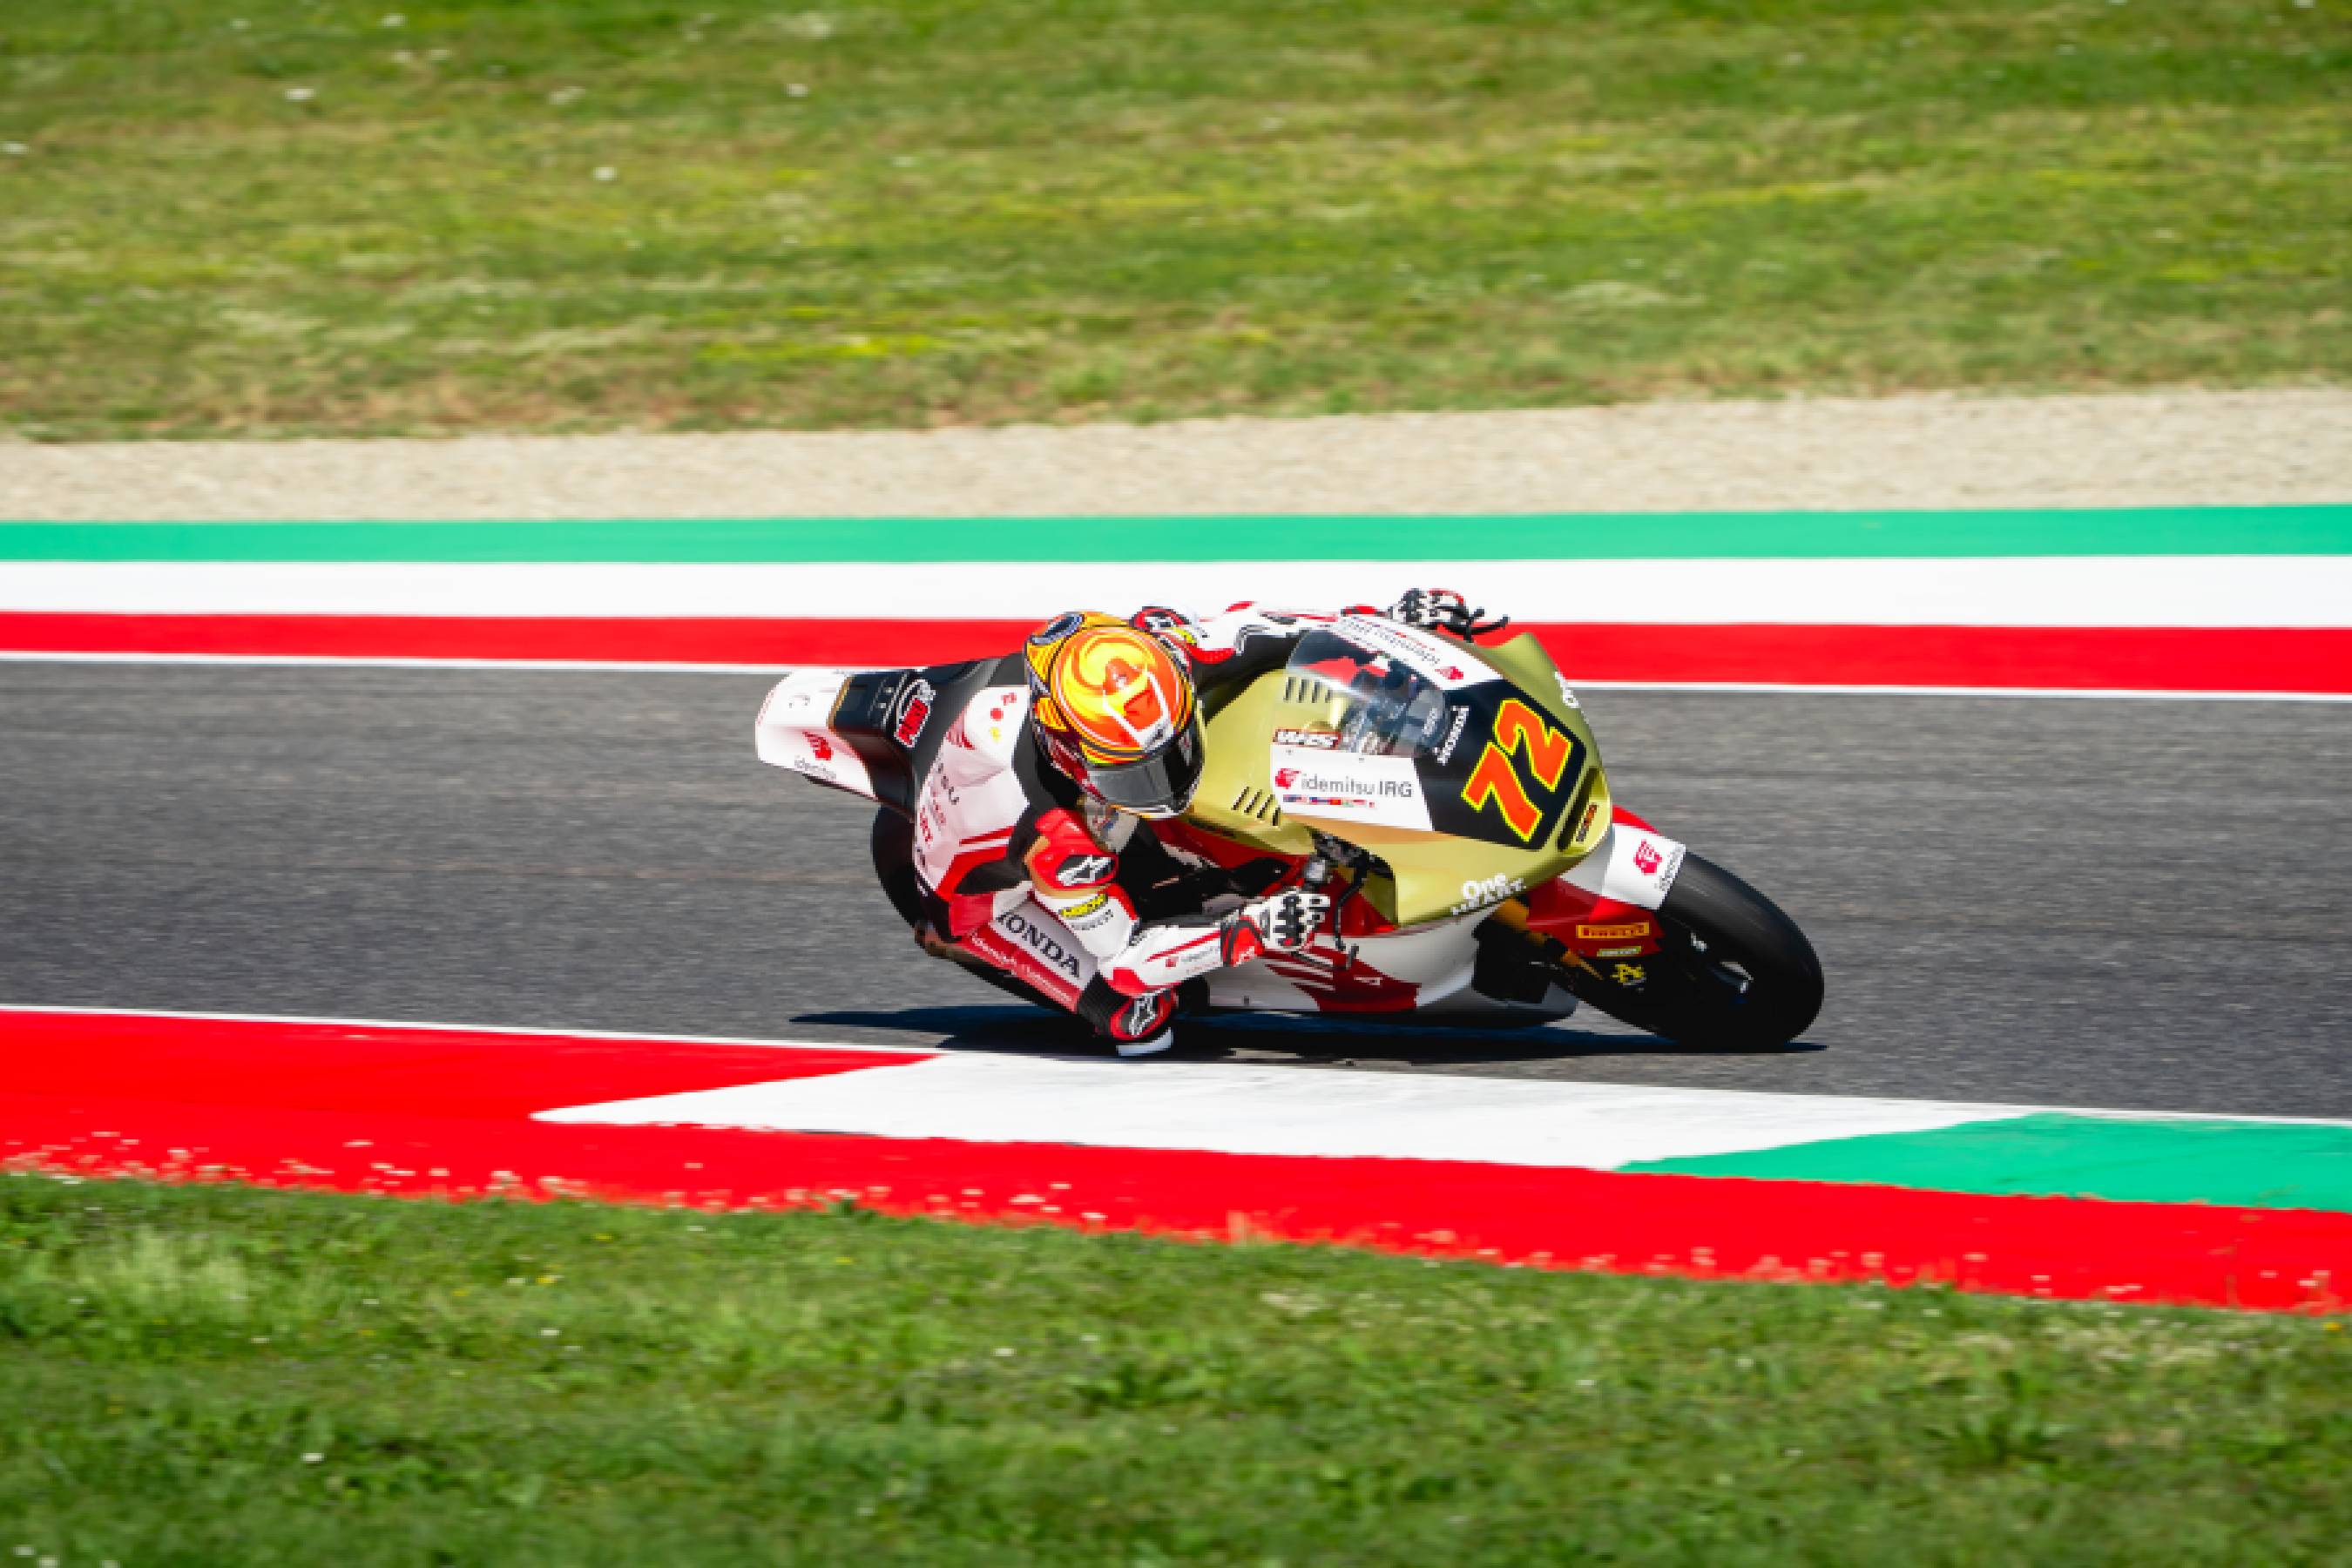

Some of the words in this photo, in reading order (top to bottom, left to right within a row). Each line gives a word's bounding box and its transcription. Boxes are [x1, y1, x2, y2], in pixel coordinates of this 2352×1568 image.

[1462, 699, 1571, 841] 72
[1301, 773, 1375, 794] idemitsu
[1379, 781, 1413, 798] IRG
[1462, 873, 1506, 901] One
